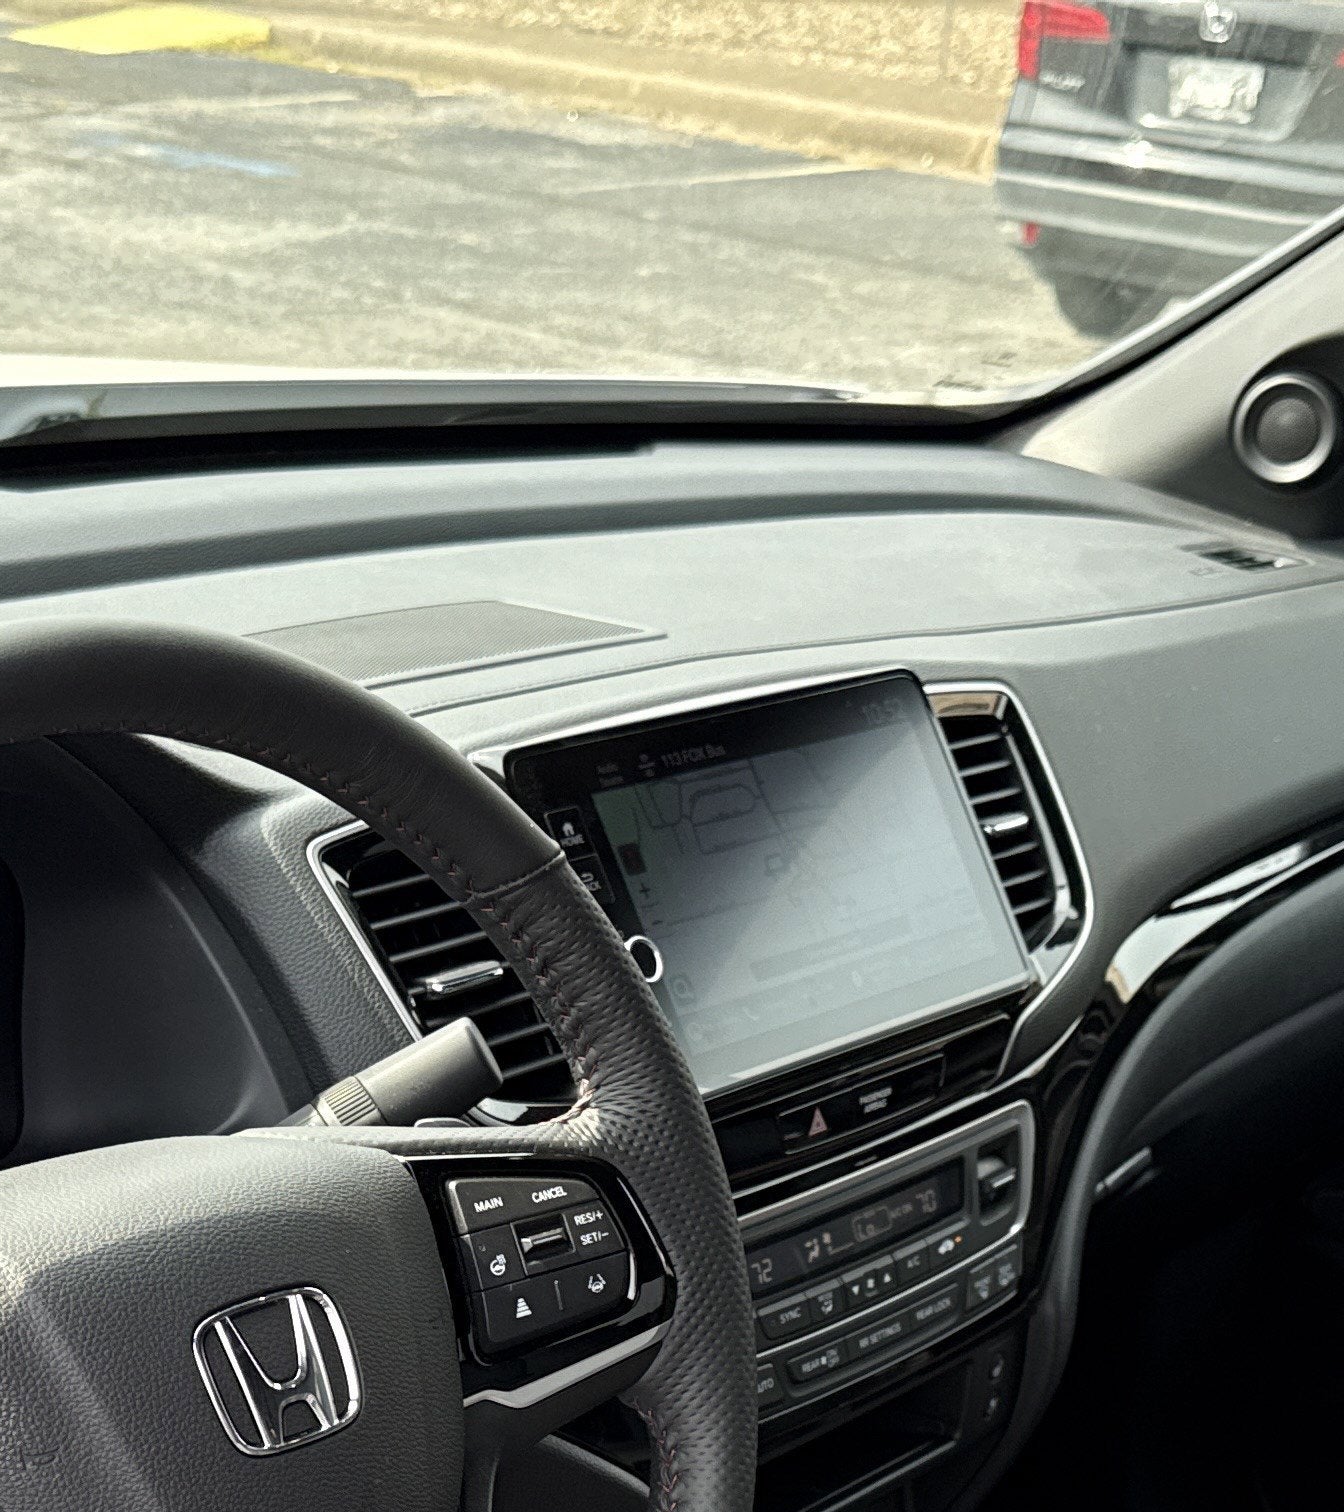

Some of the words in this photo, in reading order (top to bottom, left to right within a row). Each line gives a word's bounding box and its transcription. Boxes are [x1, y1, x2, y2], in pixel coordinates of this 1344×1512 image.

[531, 1185, 568, 1204] CANCEL
[473, 1197, 504, 1213] MAIN
[573, 1211, 604, 1226] RES/+
